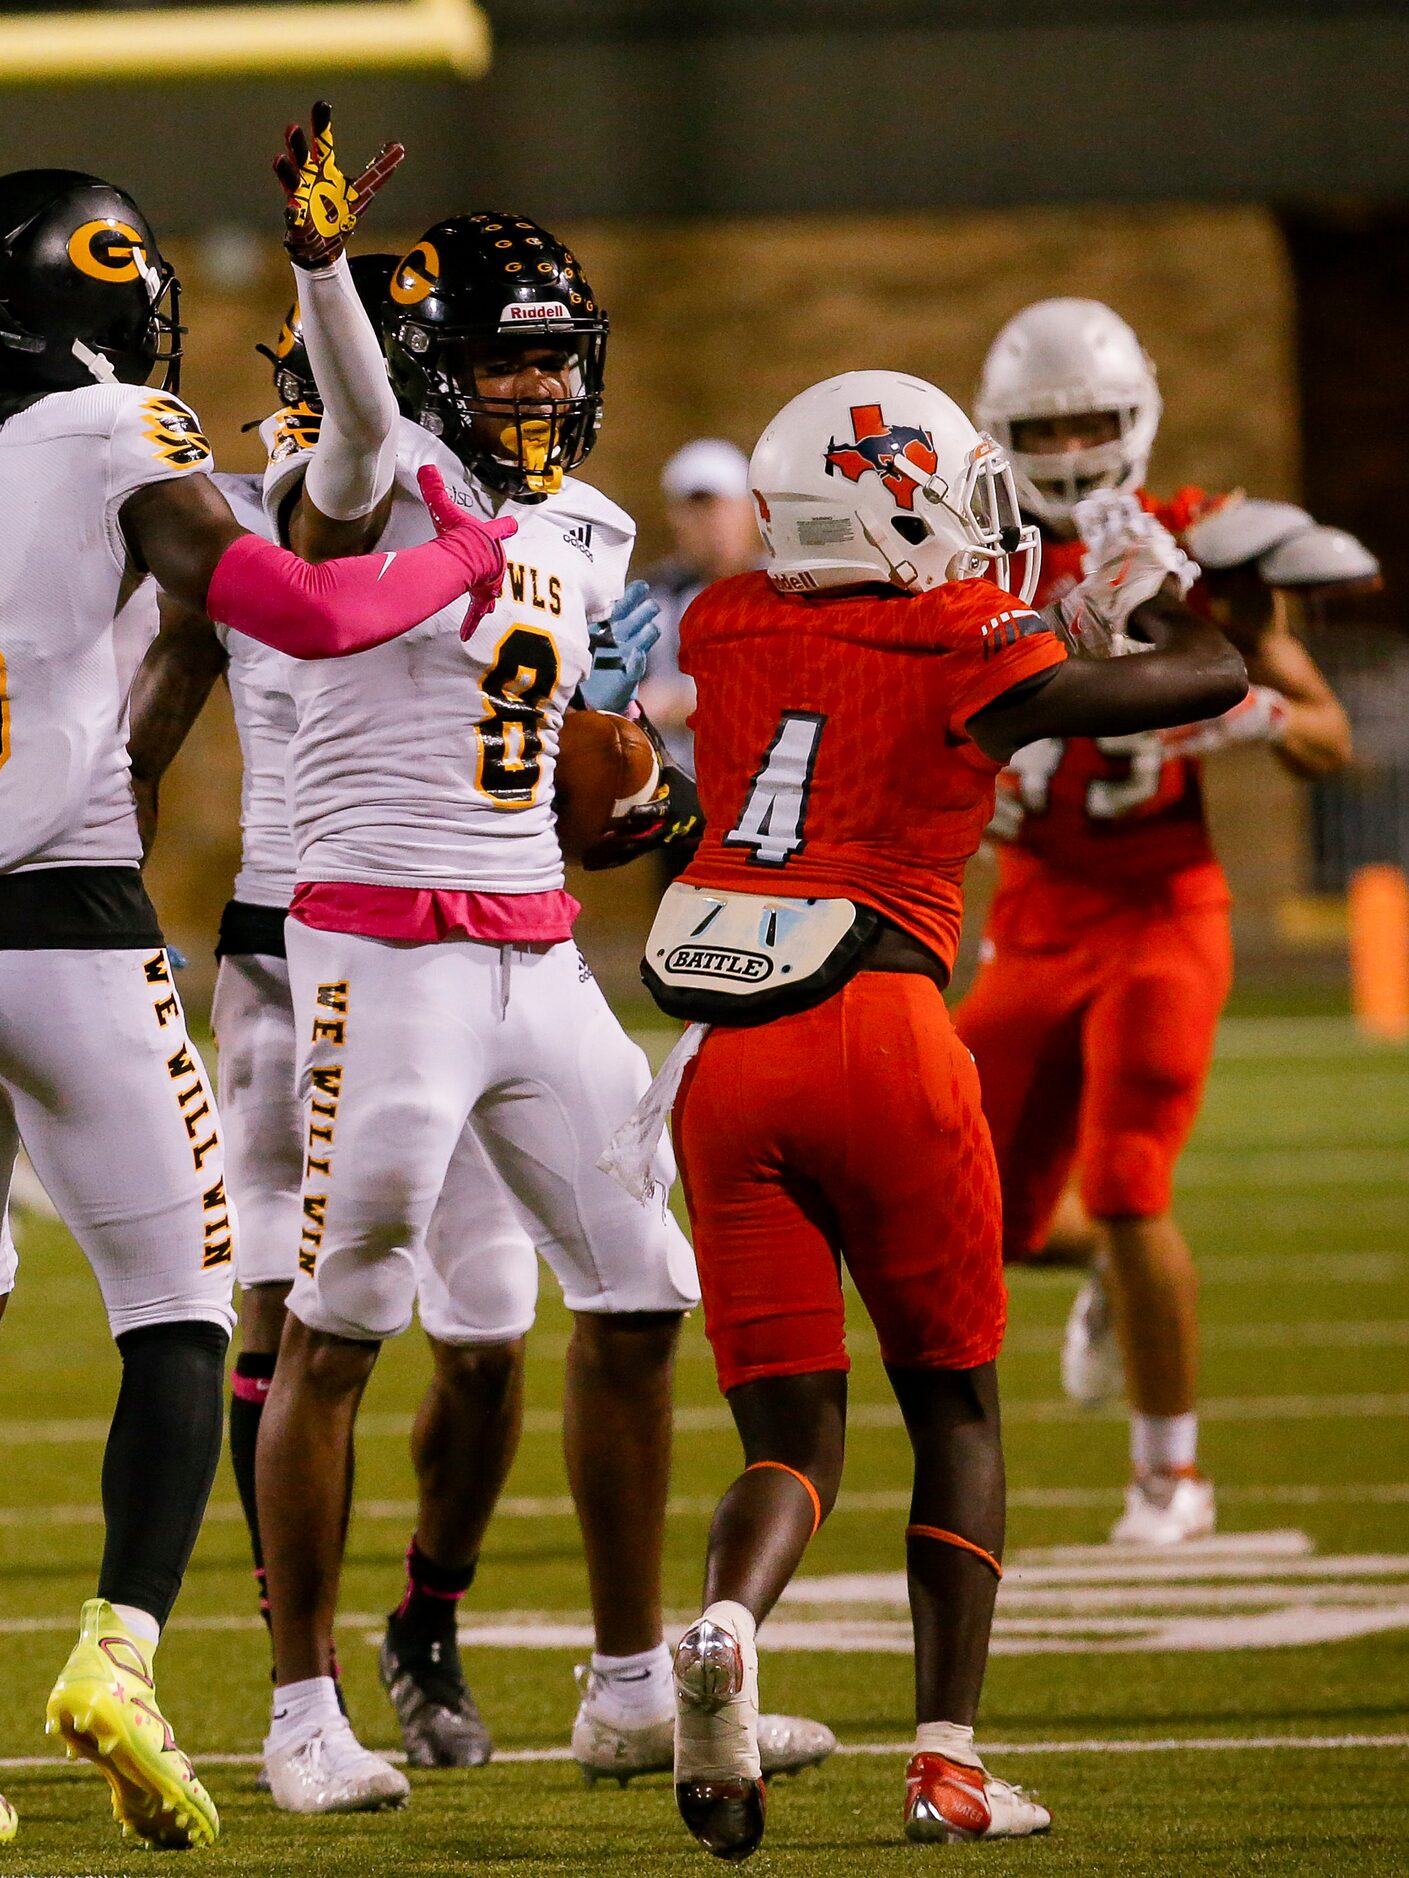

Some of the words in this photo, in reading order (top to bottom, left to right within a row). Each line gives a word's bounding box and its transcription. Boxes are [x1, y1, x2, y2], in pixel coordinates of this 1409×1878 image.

[67, 218, 147, 283] G
[510, 305, 563, 319] Riddell
[498, 559, 563, 618] WLS
[474, 622, 561, 809] 8
[723, 708, 828, 867] 4
[673, 950, 764, 978] BATTLE
[312, 980, 349, 1047] WE
[144, 949, 182, 1028] WE
[166, 1038, 219, 1173] WILL
[201, 1174, 232, 1270] WIN
[306, 1065, 343, 1178] WILL
[299, 1194, 328, 1278] WIN
